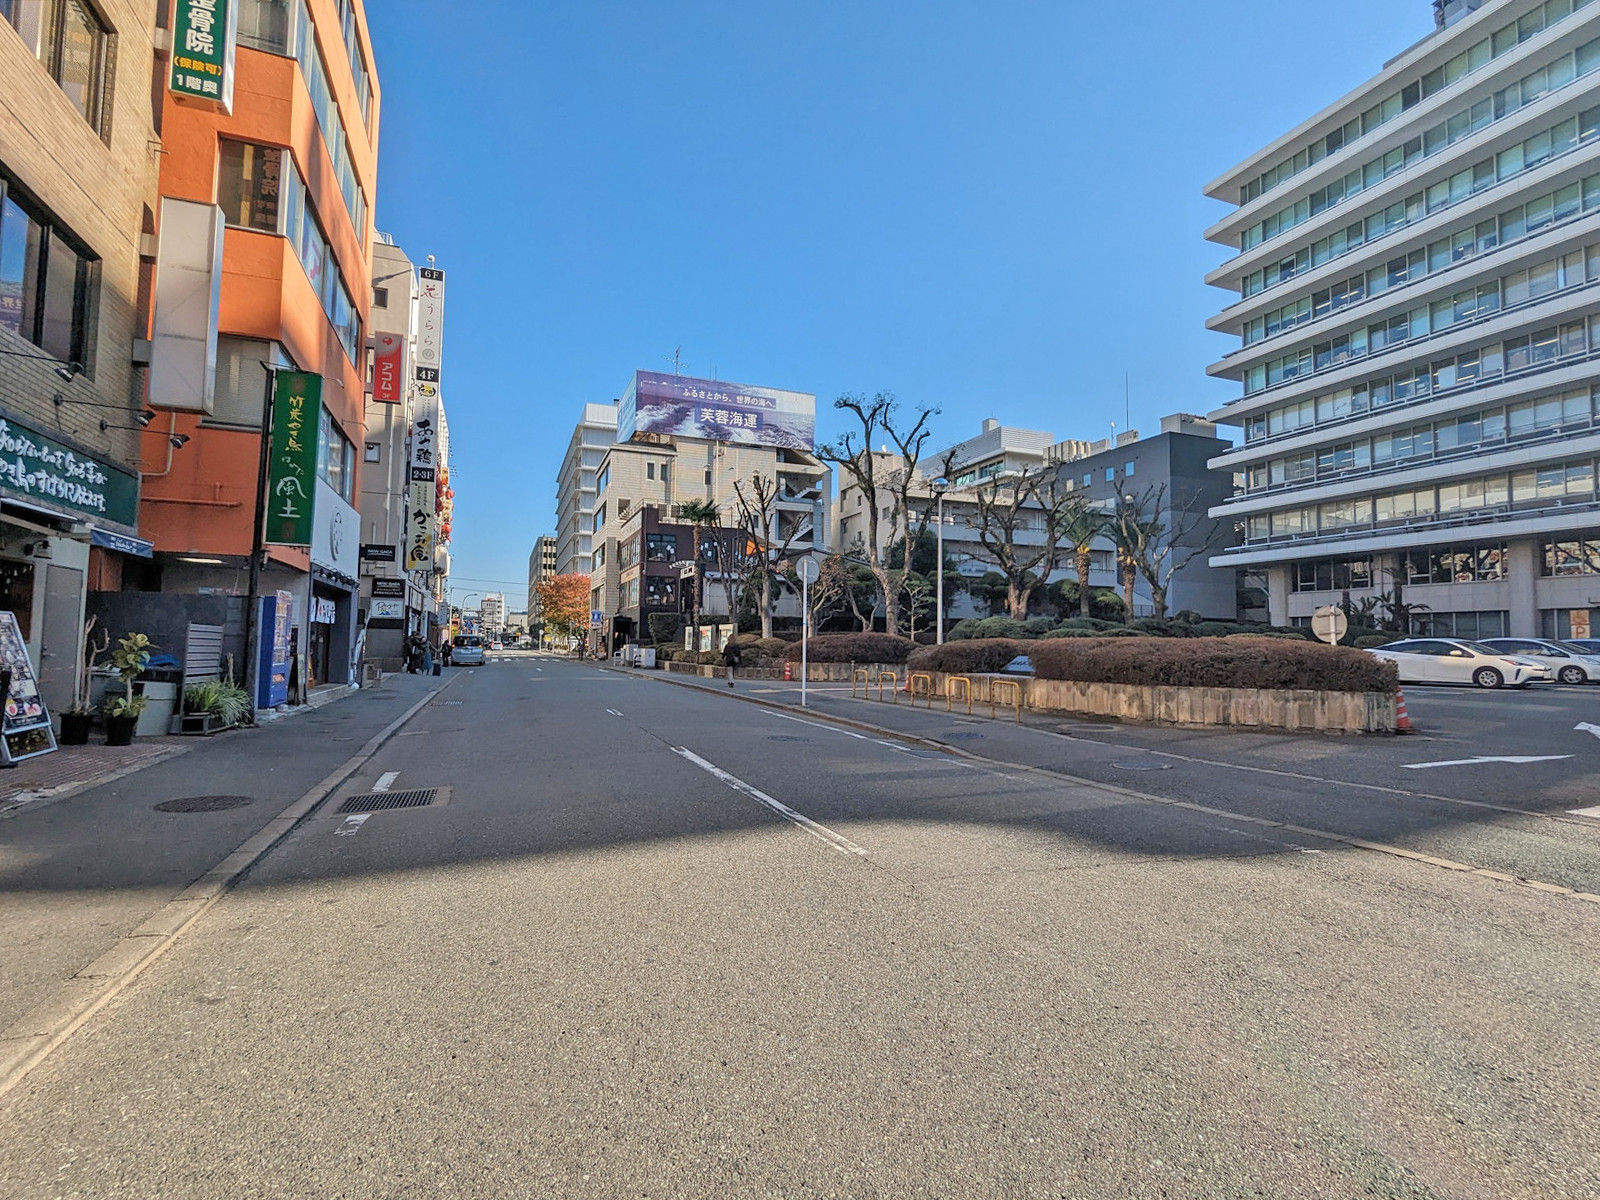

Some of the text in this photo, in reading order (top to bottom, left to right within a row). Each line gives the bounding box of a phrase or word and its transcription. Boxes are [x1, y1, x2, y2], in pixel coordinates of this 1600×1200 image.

[425, 270, 440, 279] 6F
[419, 371, 435, 380] 4F
[700, 408, 758, 429] 芙蓉海運
[277, 476, 307, 518] 風土
